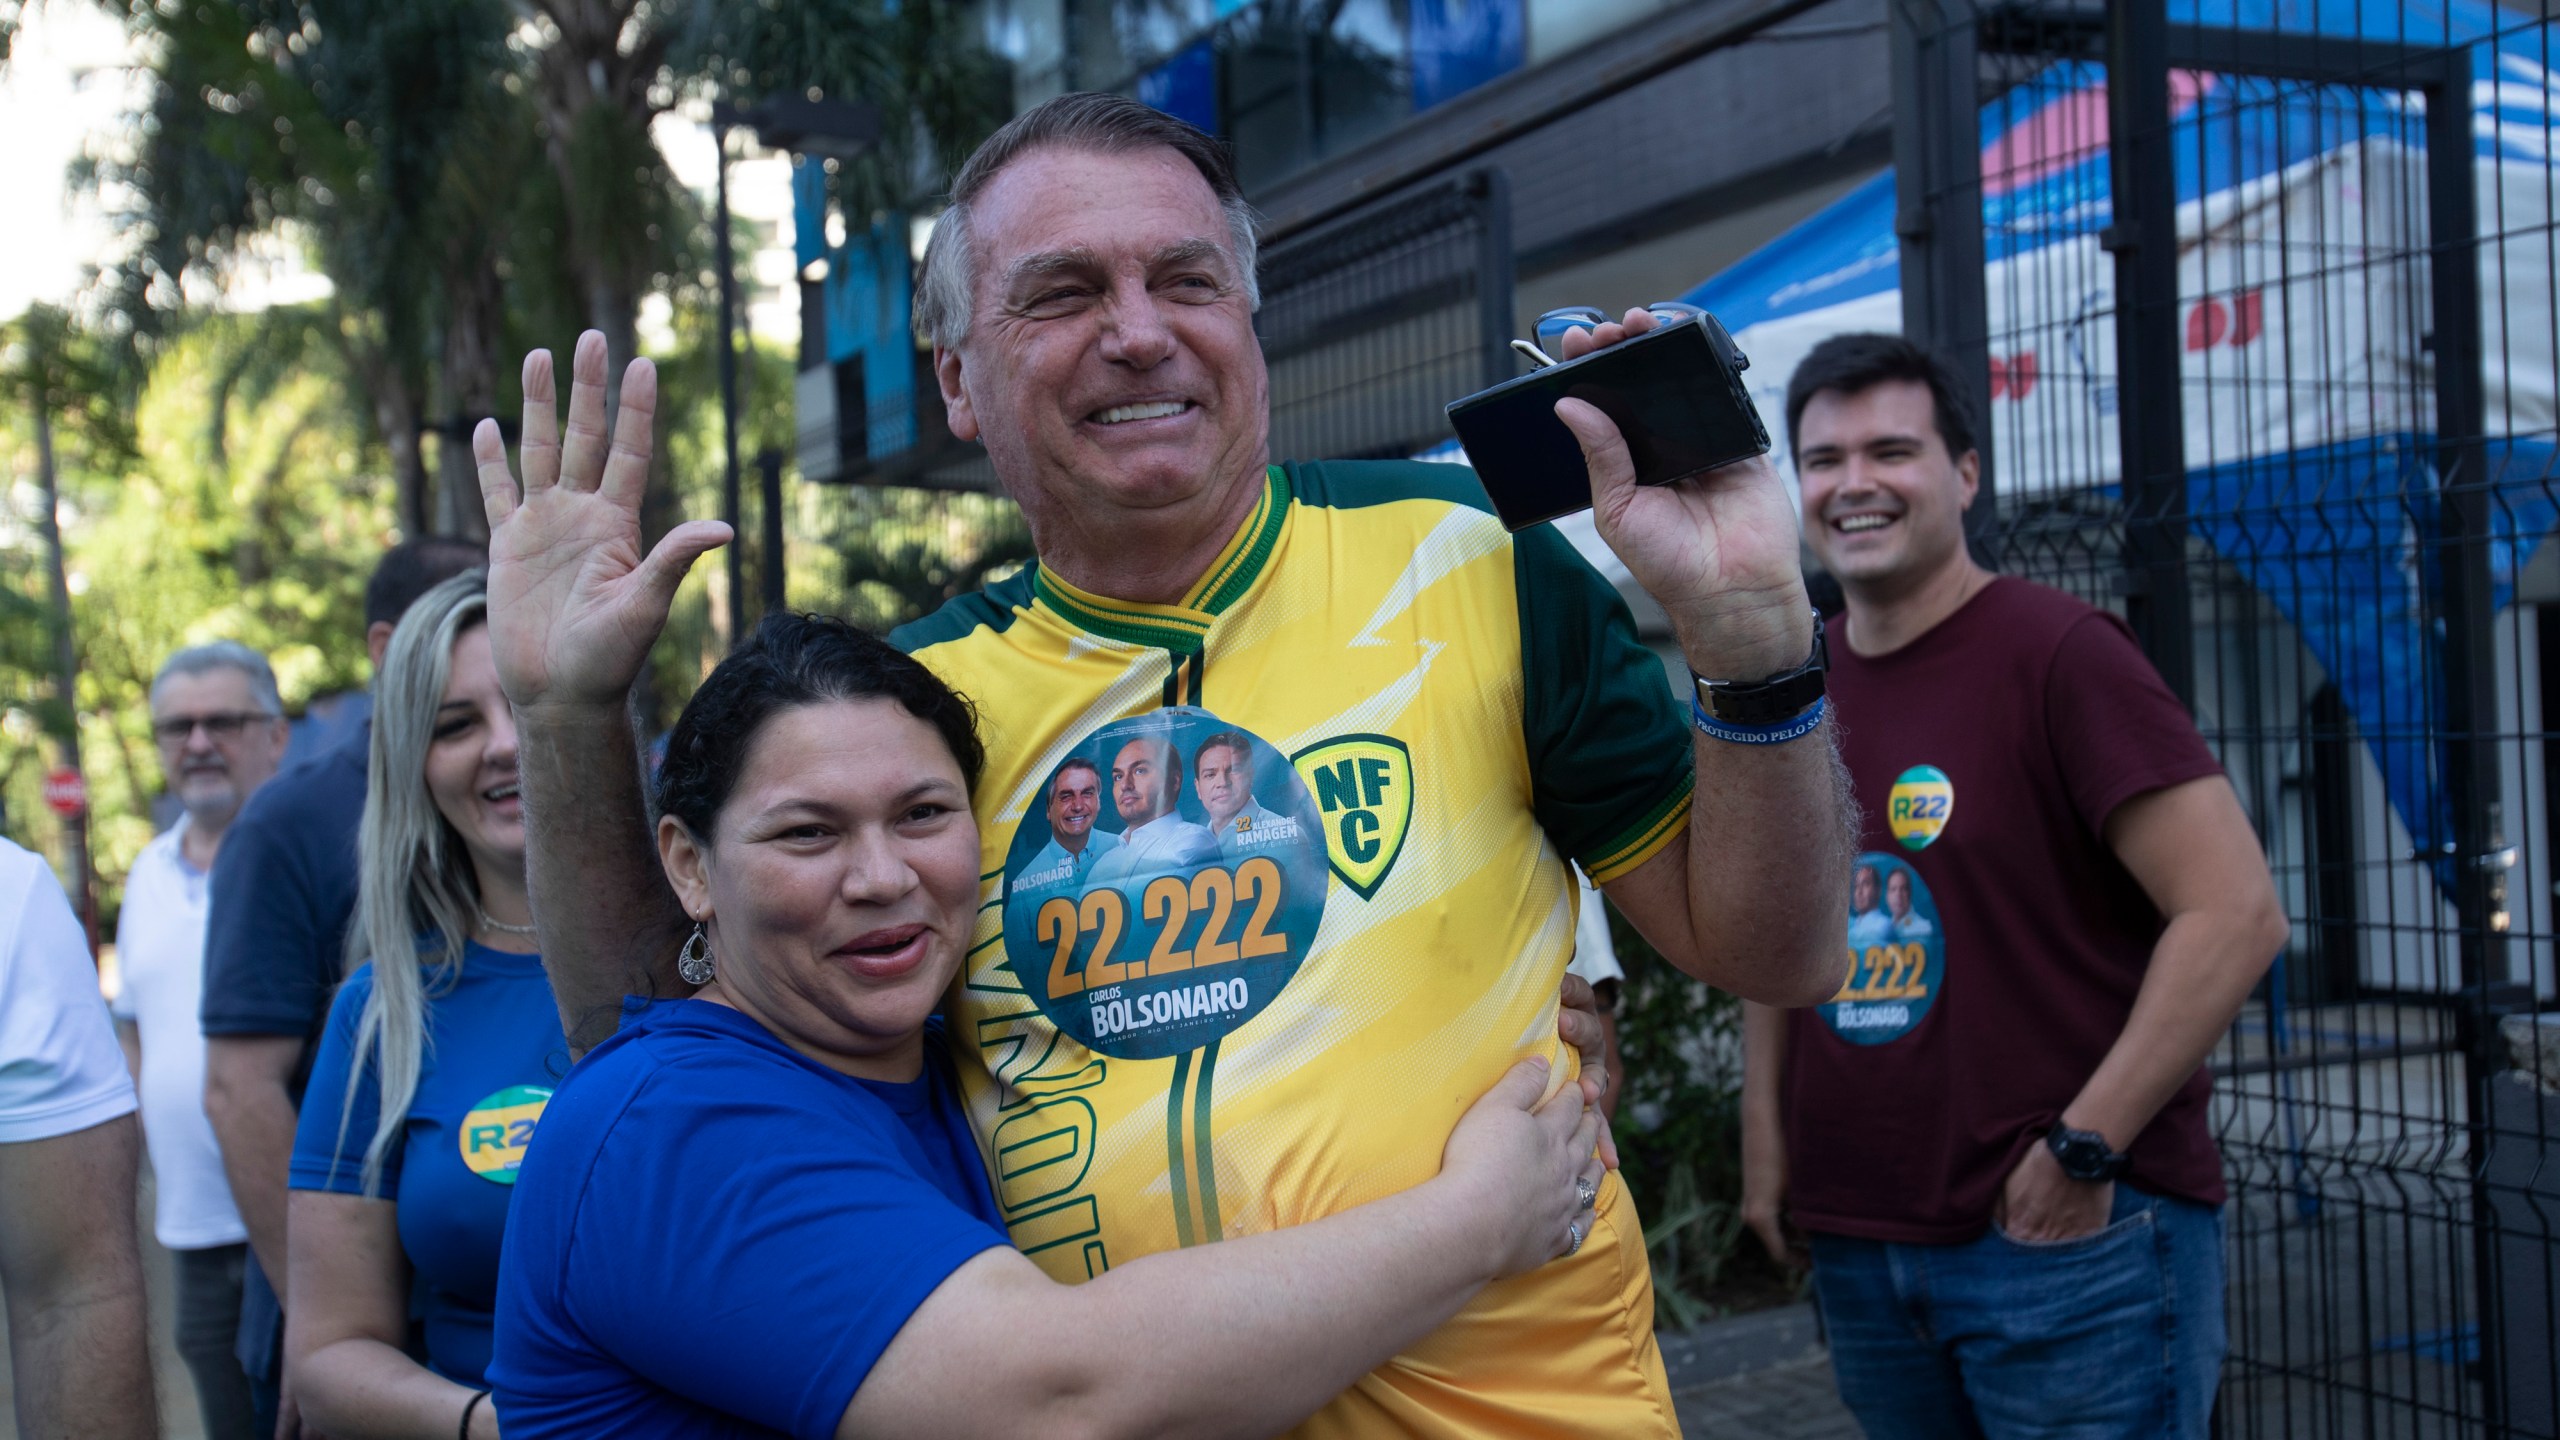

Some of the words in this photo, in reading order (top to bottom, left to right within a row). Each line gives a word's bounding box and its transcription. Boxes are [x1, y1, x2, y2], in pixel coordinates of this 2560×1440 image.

[1697, 718, 1767, 742] PROTEGIDO
[1770, 724, 1805, 741] PELO
[1313, 757, 1390, 813] NF
[1894, 795, 1947, 821] R22
[1236, 815, 1252, 833] 22
[1253, 816, 1296, 830] ALEXANDRE
[1236, 825, 1298, 846] RAMAGEM
[1340, 809, 1381, 864] C
[1058, 857, 1072, 867] JAIR
[1012, 865, 1072, 893] BOLSONARO
[1037, 857, 1288, 1000] 22.222
[1089, 986, 1121, 1004] CARLOS
[1091, 977, 1248, 1038] BOLSONARO
[1101, 1033, 1136, 1045] VEREADOR
[1180, 1018, 1214, 1028] JANEIRO
